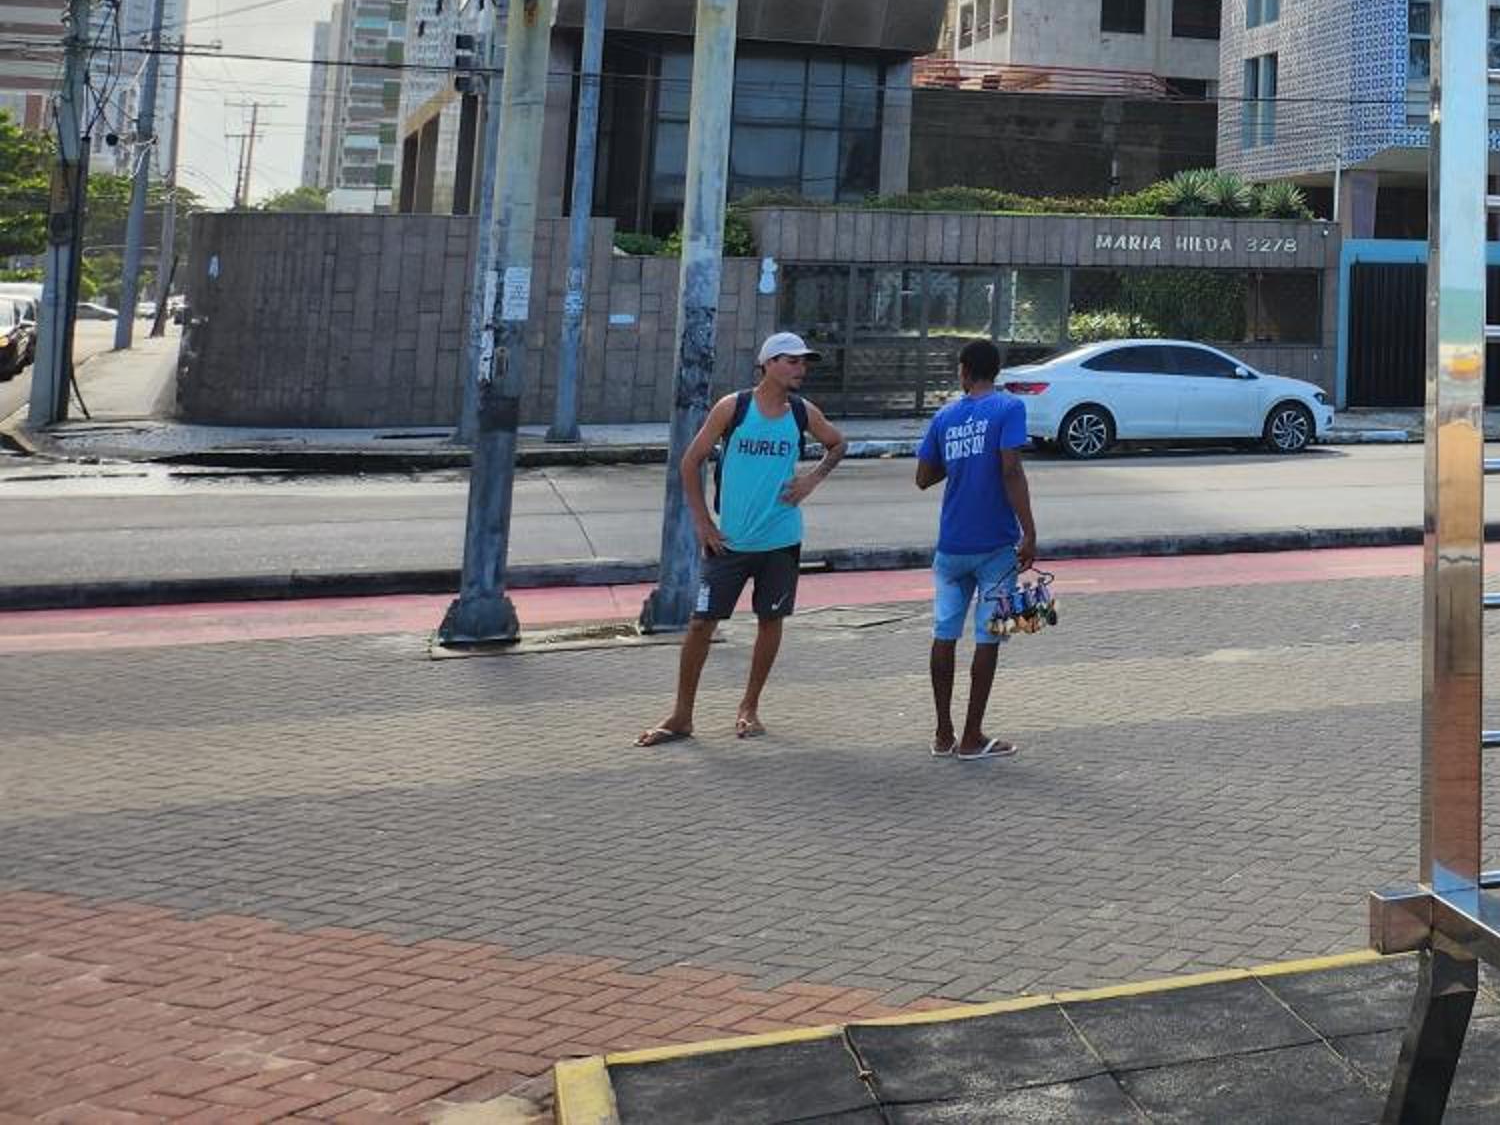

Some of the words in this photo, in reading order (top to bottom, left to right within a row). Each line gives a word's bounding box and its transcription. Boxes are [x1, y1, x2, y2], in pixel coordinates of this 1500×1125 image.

[1094, 234, 1162, 251] MARIA
[1175, 235, 1233, 252] HILDA
[1246, 237, 1298, 253] 3278
